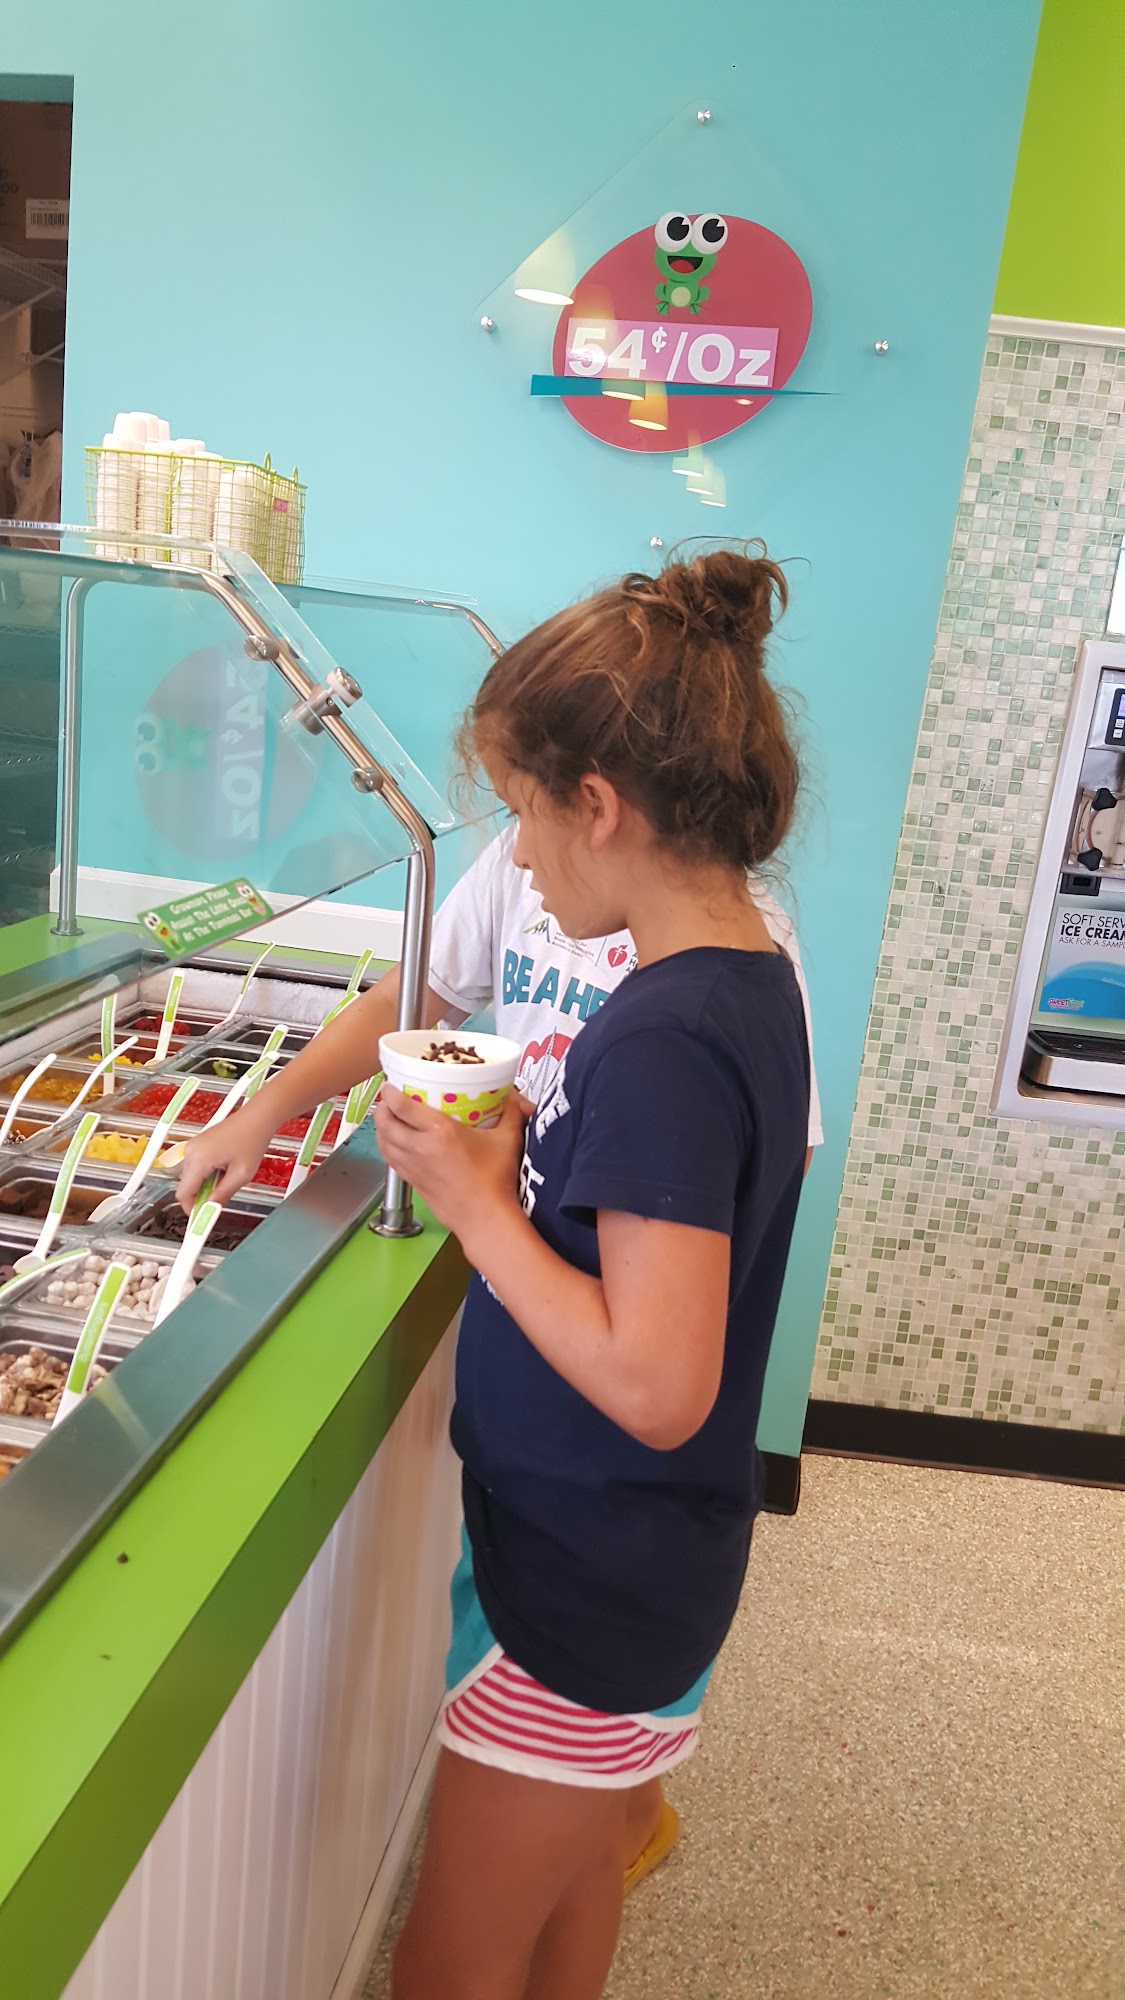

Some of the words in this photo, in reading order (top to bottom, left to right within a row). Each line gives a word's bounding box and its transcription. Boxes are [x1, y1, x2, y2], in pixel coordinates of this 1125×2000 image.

[1062, 913, 1095, 926] SOFT
[1060, 924, 1082, 937] ICE
[1059, 936, 1074, 944] ASK
[1076, 938, 1092, 946] FOR
[503, 948, 534, 1005] BE
[531, 966, 560, 1008] A
